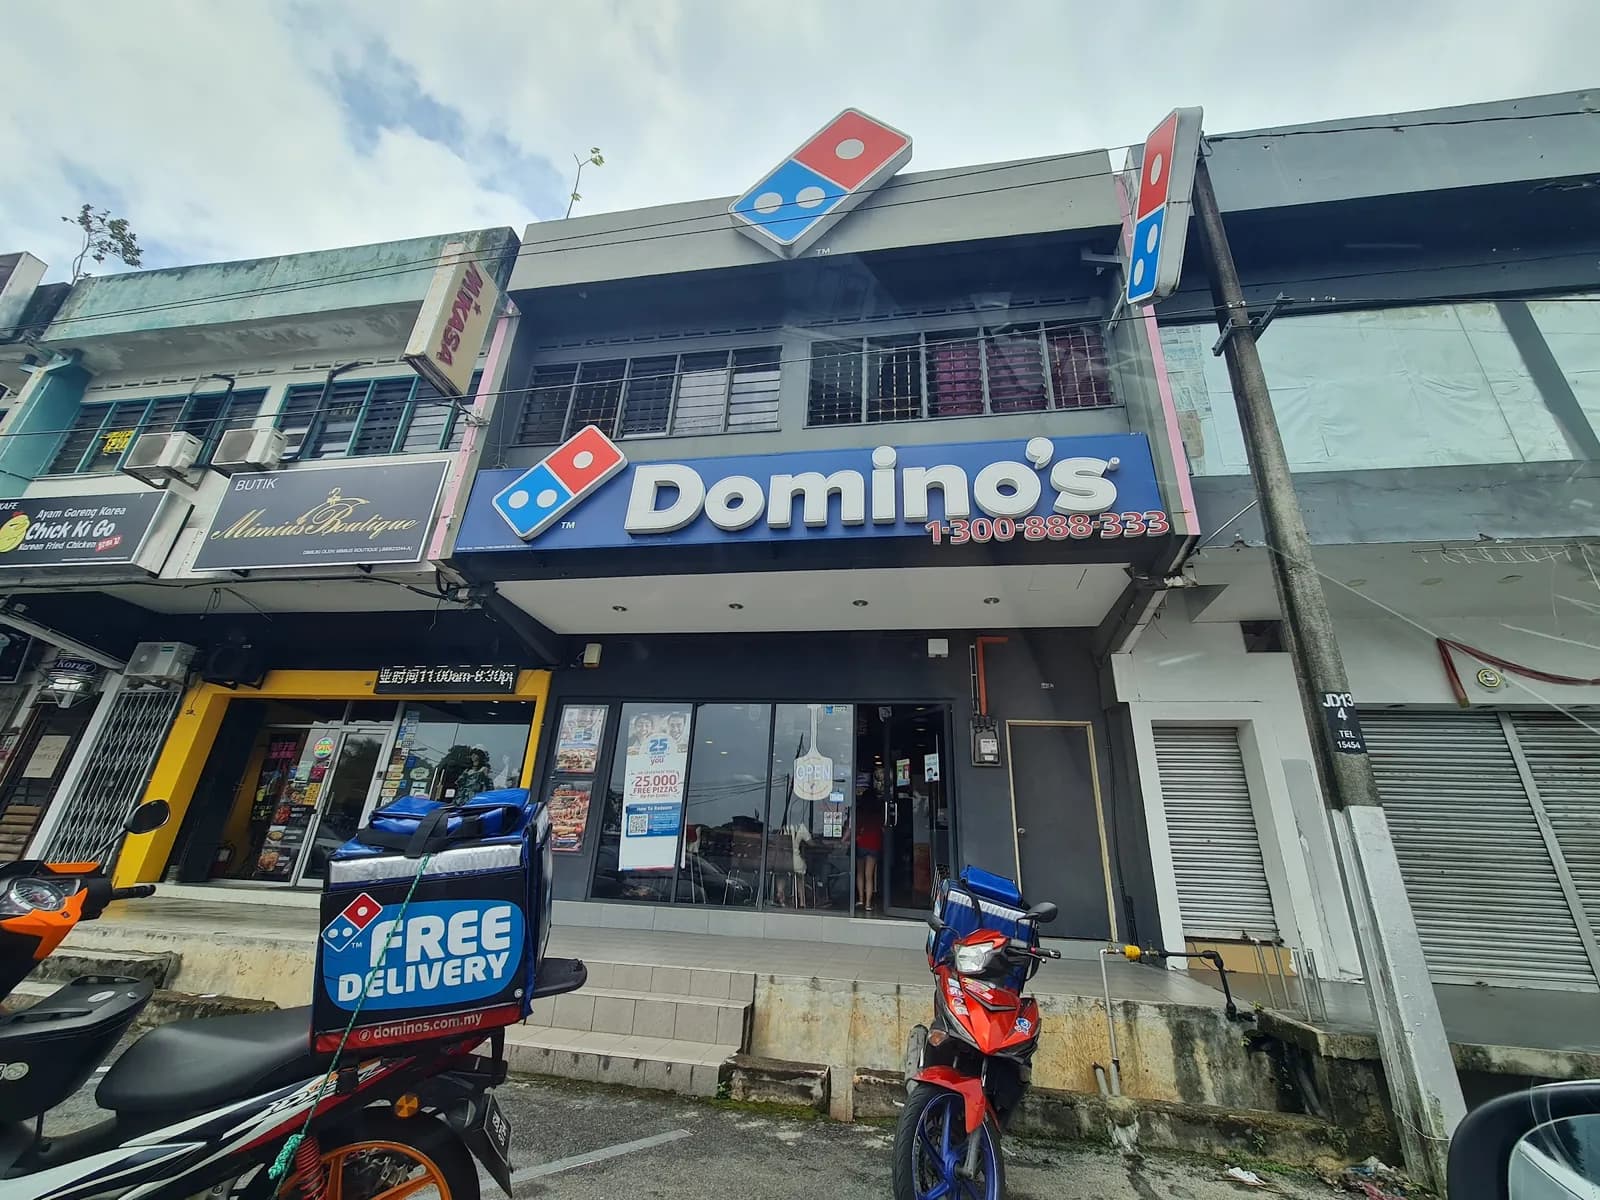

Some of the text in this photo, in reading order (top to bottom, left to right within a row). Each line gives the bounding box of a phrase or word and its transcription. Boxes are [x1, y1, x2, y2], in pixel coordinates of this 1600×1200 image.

[234, 478, 279, 491] BUTIK
[624, 437, 1117, 535] Domino's
[36, 506, 127, 520] Ayam Goreng Korea
[304, 502, 419, 540] Boutique
[561, 521, 576, 530] TM
[924, 510, 1170, 545] 1-300-888-333
[25, 519, 116, 540] Chick Ki Go
[18, 542, 45, 551] Korean
[45, 542, 64, 550] Fried
[66, 541, 97, 549] Chicken
[1322, 693, 1355, 708] JD13
[1337, 707, 1348, 721] 4
[1339, 730, 1356, 738] TEL
[649, 738, 668, 752] 25
[650, 756, 664, 766] you
[796, 764, 831, 782] OPEN
[653, 785, 678, 793] PIZZAS
[369, 905, 512, 967] FREE
[337, 951, 510, 1002] DELIVERY
[373, 1012, 482, 1040] dominos.com.my
